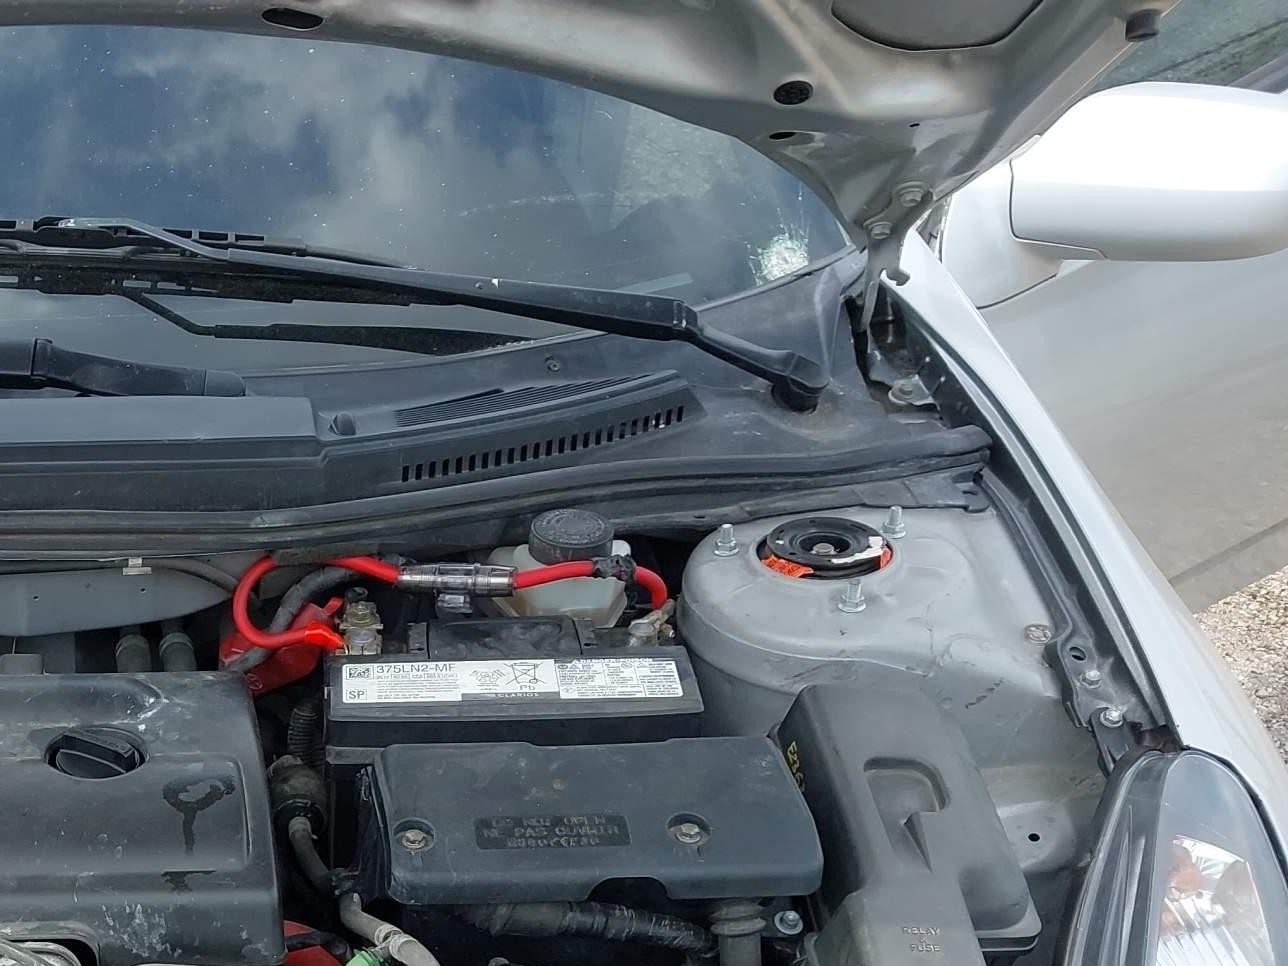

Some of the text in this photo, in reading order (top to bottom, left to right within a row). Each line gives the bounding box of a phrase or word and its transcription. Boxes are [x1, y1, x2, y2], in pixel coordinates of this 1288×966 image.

[376, 663, 457, 674] 375LN2-MF
[348, 690, 365, 700] SP
[902, 926, 940, 936] RELAY
[909, 944, 941, 952] FUSE
